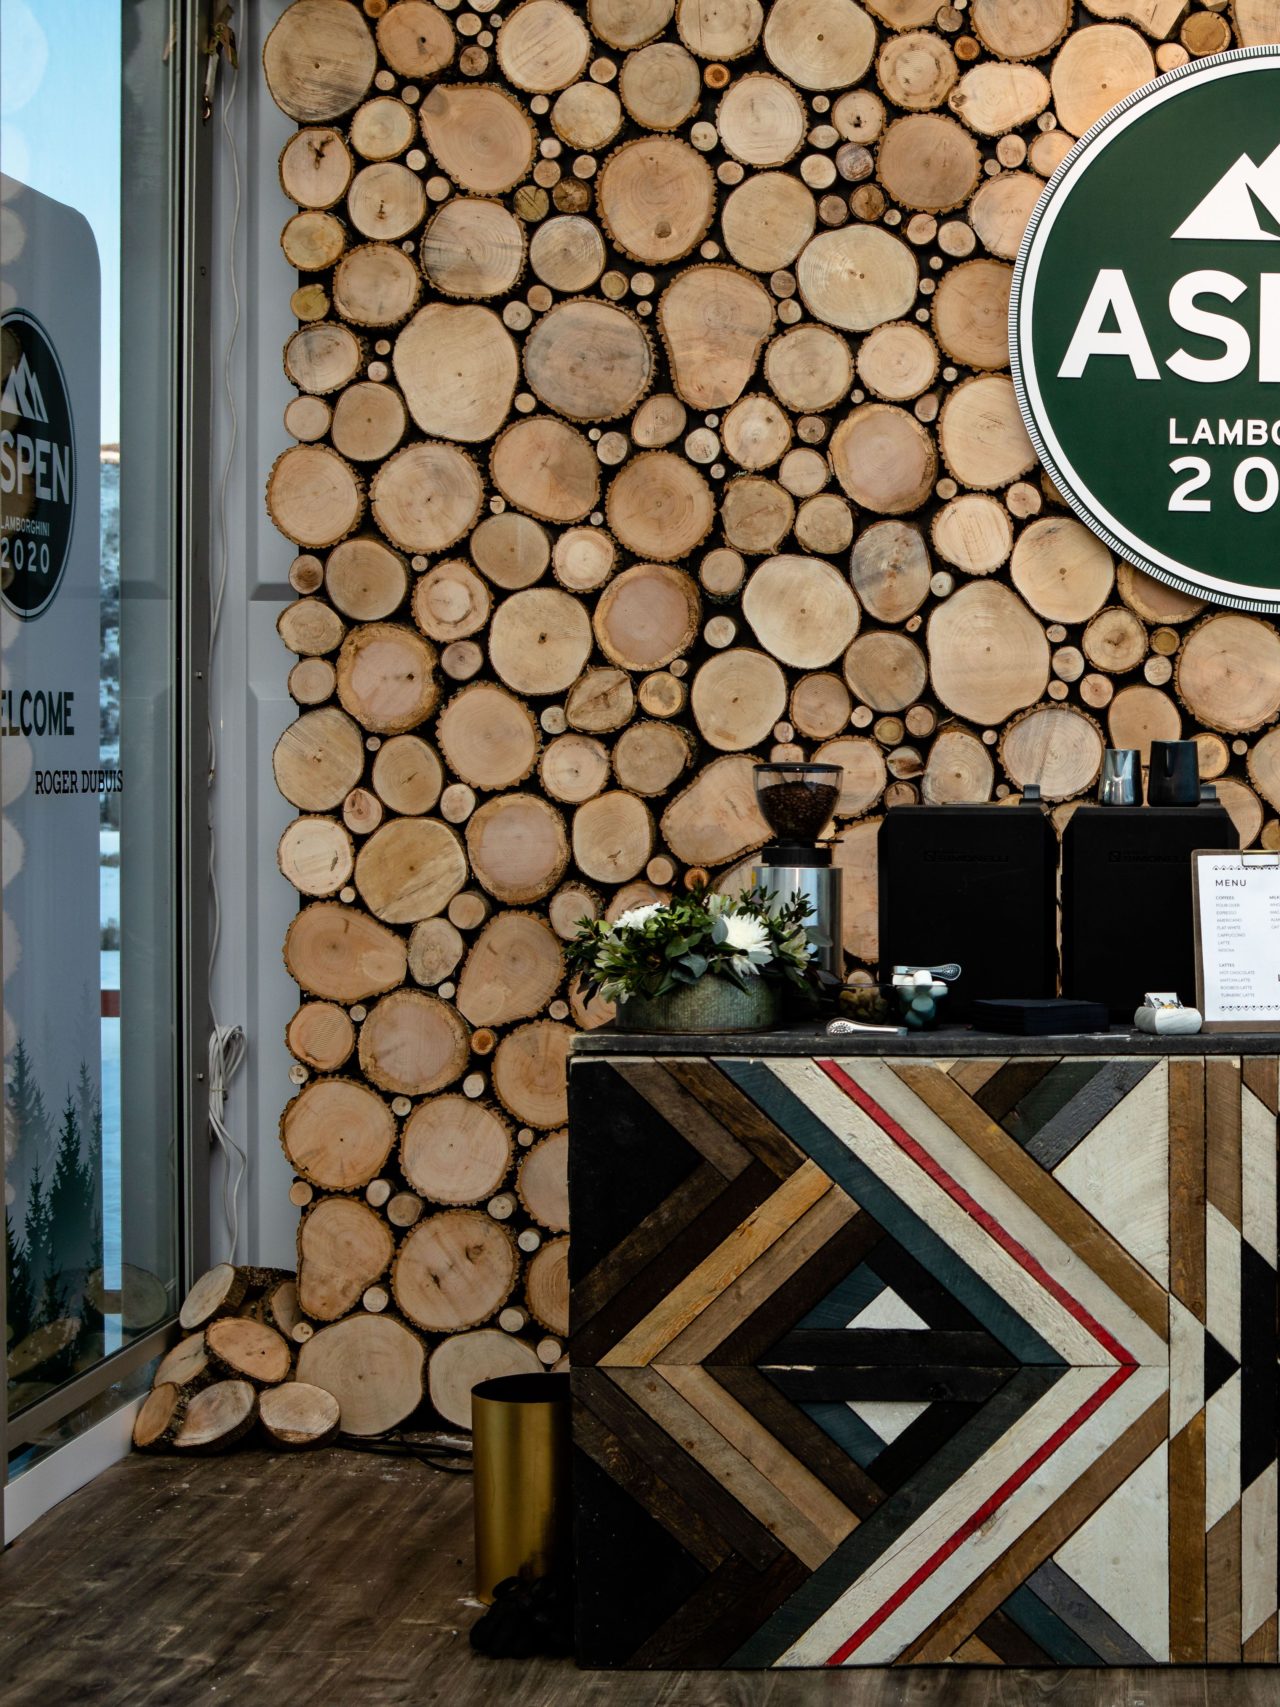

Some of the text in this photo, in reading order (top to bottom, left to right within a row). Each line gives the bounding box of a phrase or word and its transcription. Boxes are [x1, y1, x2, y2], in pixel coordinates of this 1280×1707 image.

[0, 537, 50, 574] 2020
[35, 770, 123, 794] ROGER DUBUIS
[1215, 879, 1247, 887] MENU
